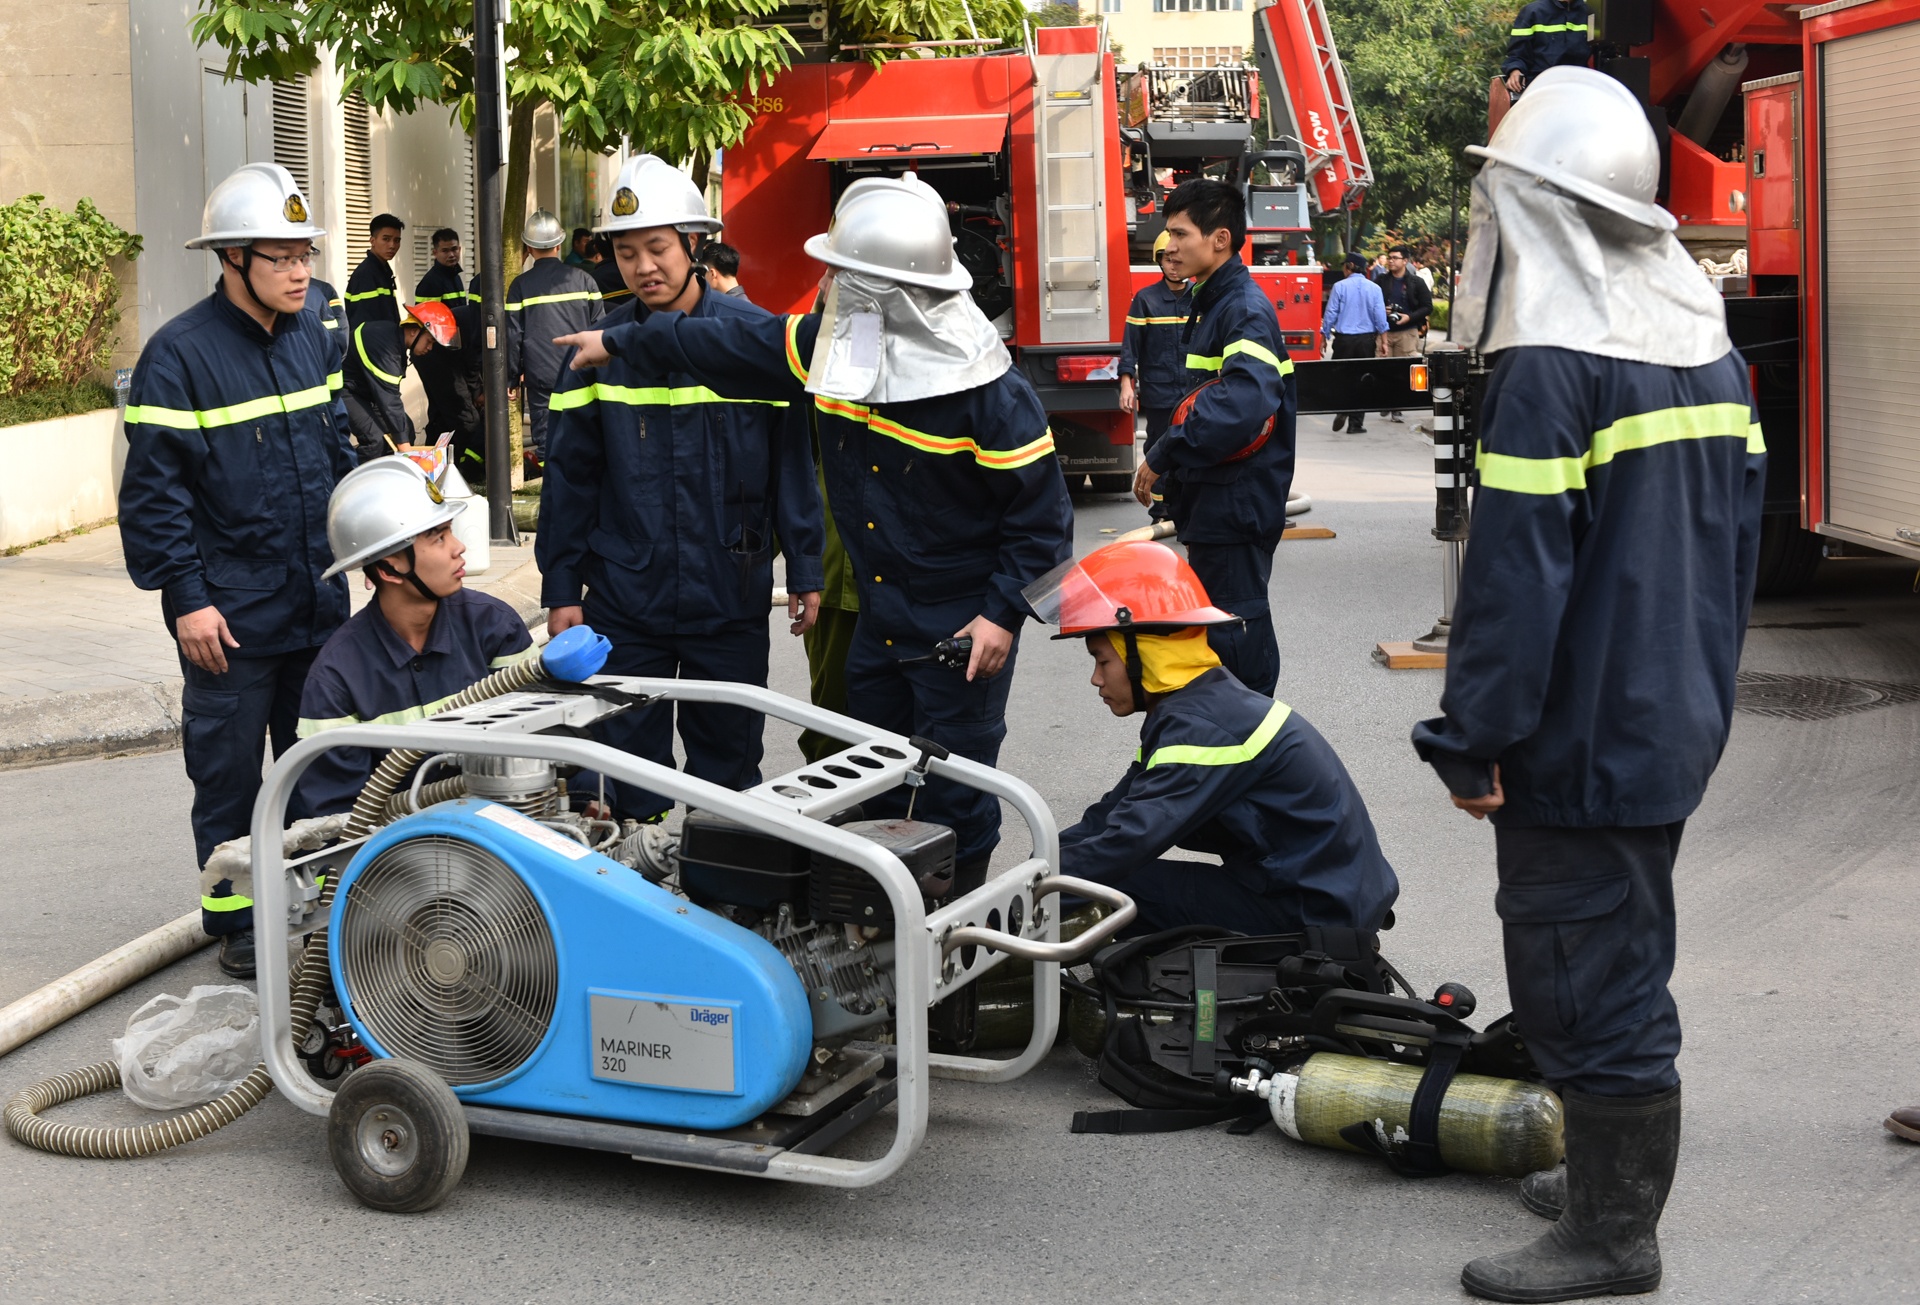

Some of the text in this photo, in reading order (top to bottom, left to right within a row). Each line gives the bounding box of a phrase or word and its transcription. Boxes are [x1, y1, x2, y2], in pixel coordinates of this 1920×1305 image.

[752, 97, 783, 113] PS6
[1308, 110, 1337, 183] MORTA
[1070, 456, 1119, 465] rosenbauer
[690, 1008, 730, 1026] Dräger
[1199, 991, 1214, 1039] MSA
[600, 1037, 672, 1060] MARINER
[602, 1056, 626, 1073] 320
